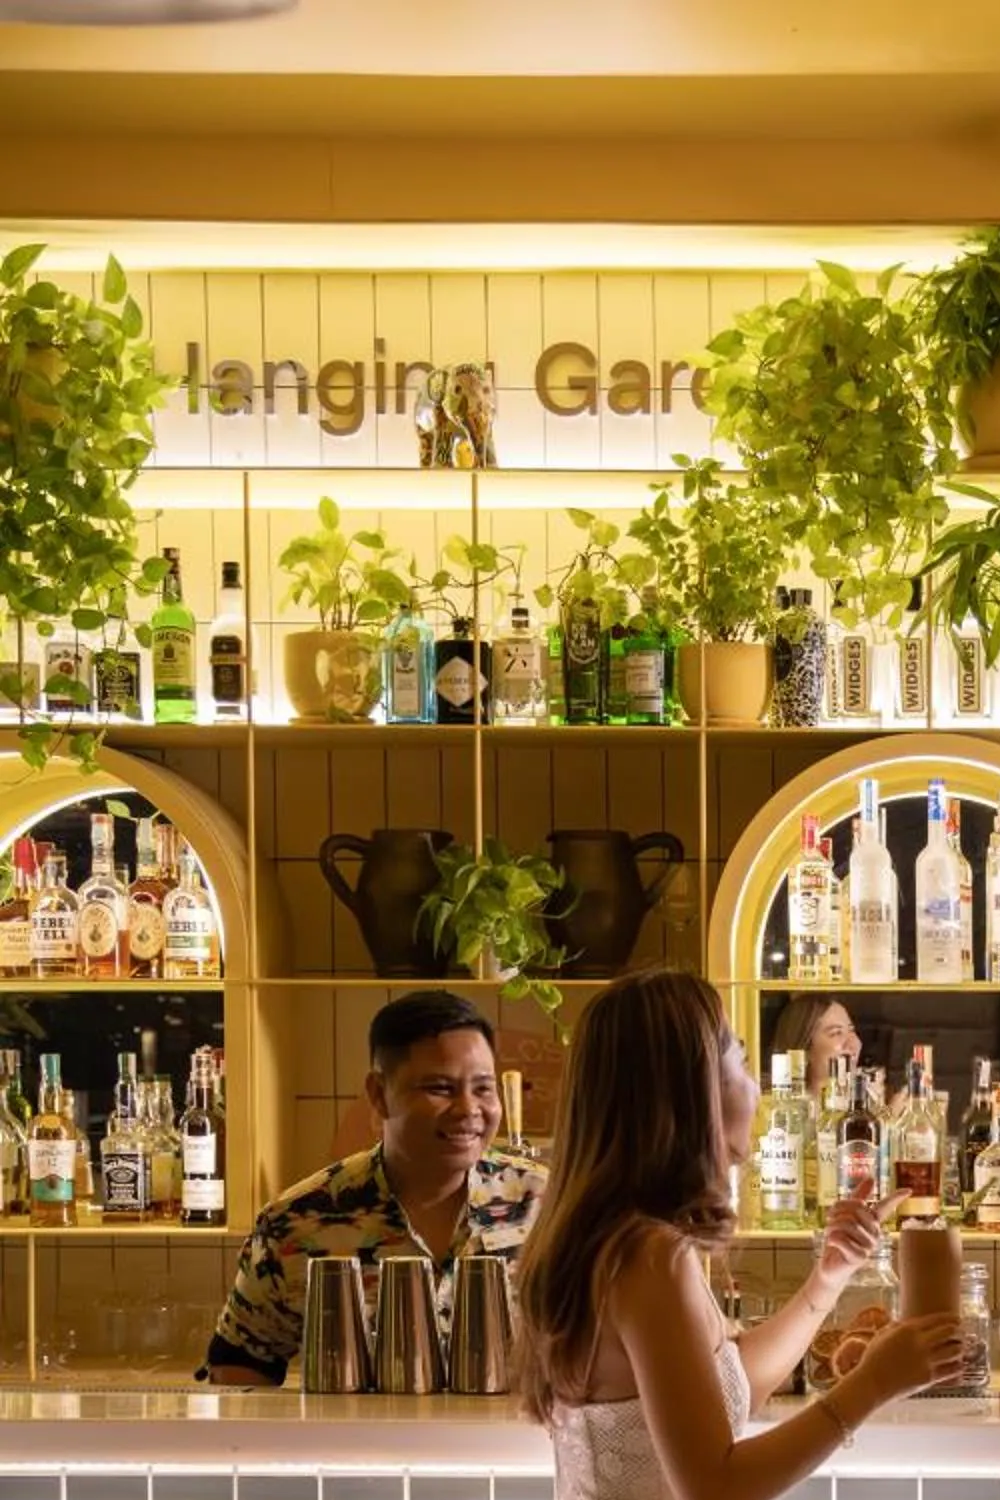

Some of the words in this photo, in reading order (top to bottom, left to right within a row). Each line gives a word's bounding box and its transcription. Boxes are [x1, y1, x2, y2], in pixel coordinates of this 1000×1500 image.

[181, 337, 495, 436] angin
[849, 640, 862, 707] WIDGES
[906, 641, 920, 708] WIDGES
